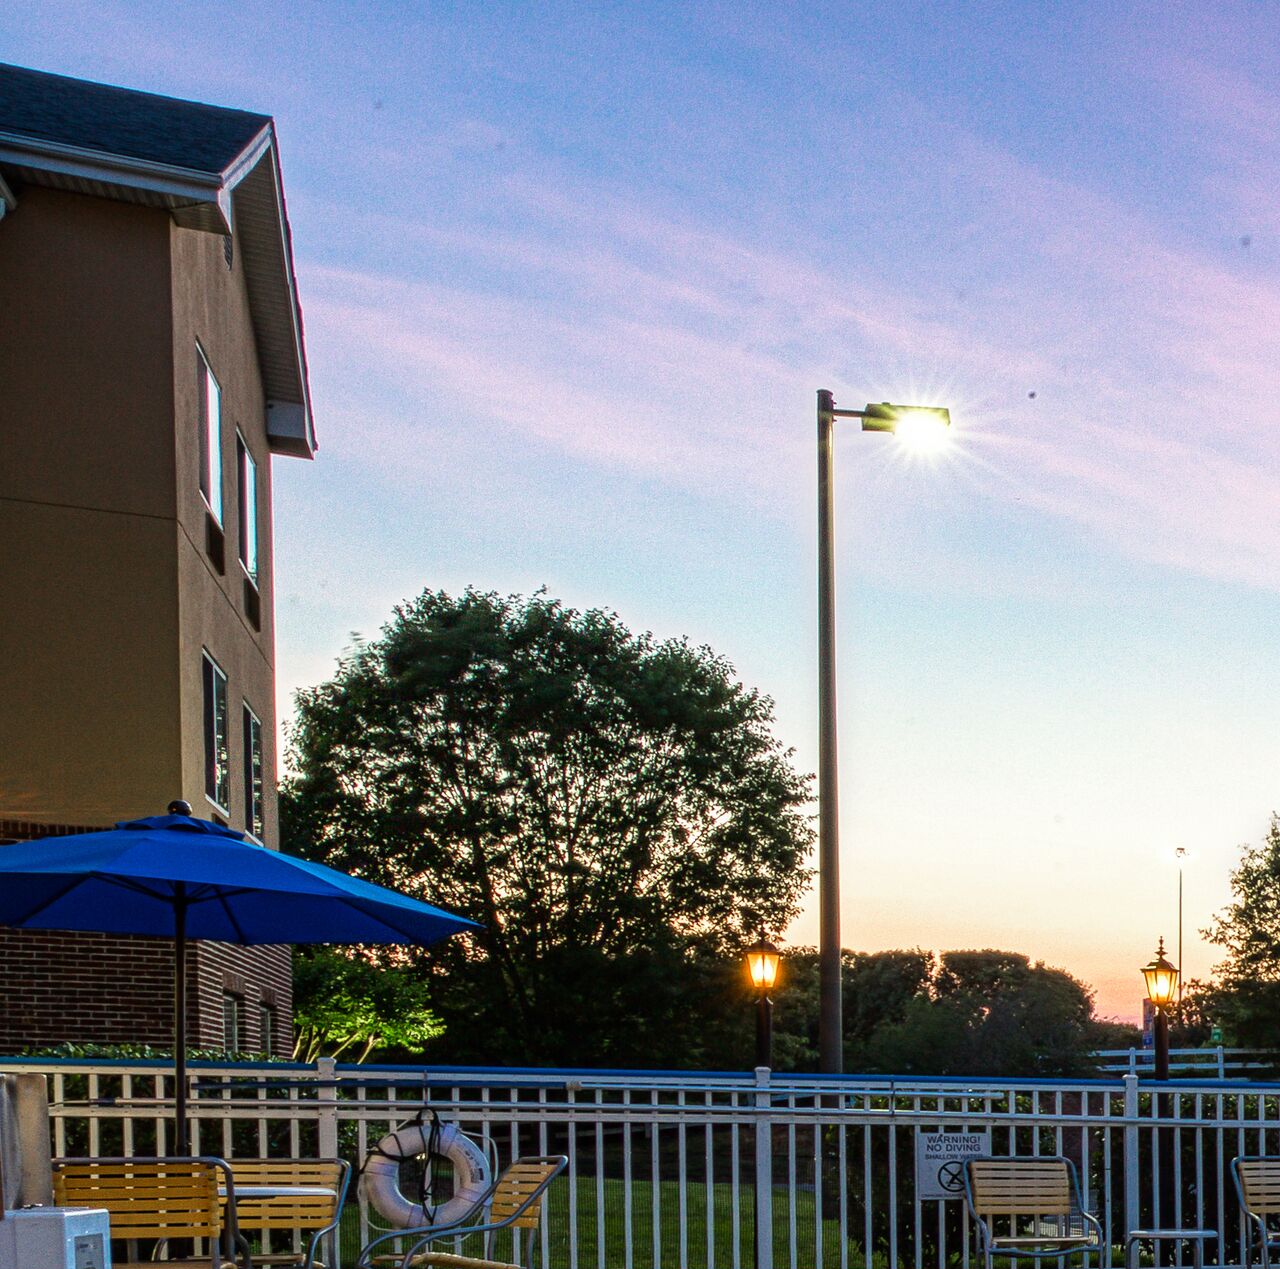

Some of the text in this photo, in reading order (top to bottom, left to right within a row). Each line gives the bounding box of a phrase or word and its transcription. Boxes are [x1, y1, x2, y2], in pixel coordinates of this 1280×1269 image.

[927, 1135, 981, 1144] WARNING!
[926, 1144, 981, 1152] NO DIVING
